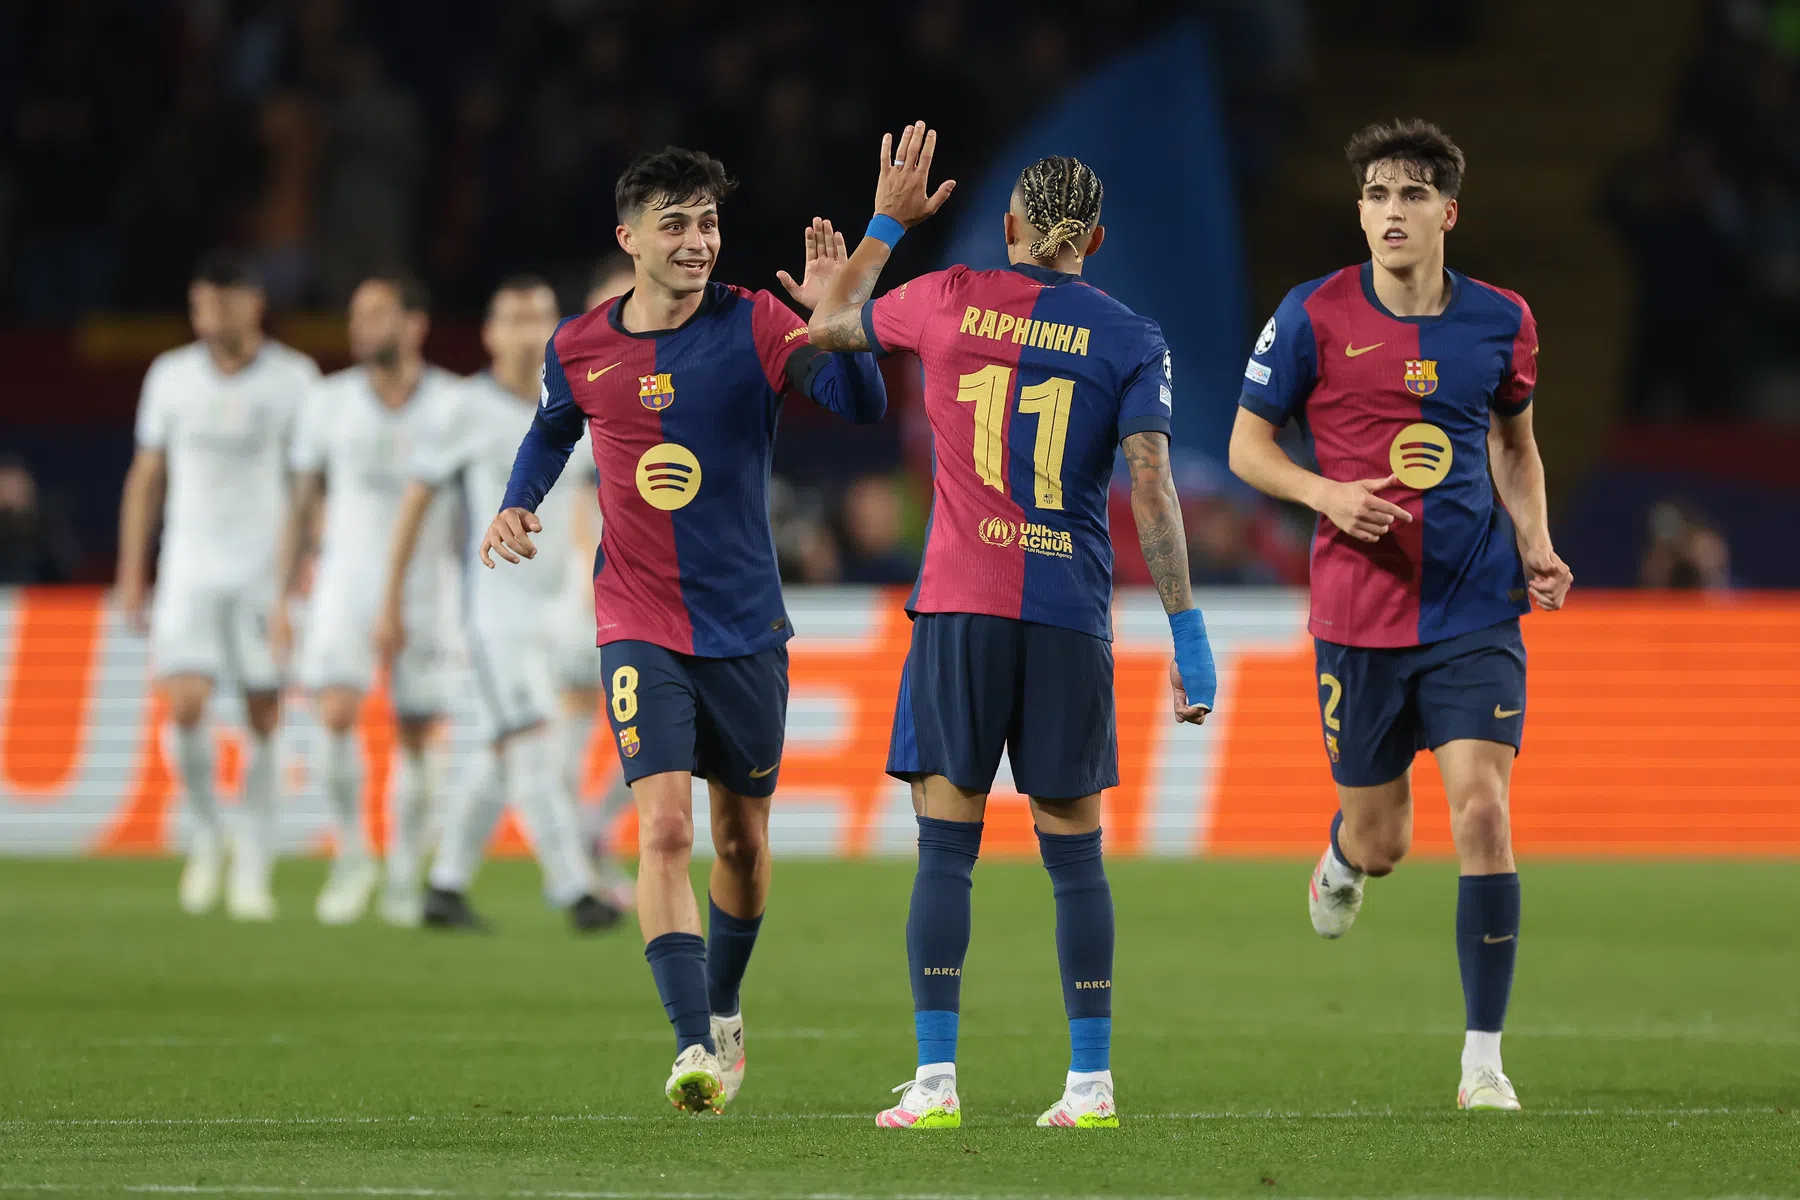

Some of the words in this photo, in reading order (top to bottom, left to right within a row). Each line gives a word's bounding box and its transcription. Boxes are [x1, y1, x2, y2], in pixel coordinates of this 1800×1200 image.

[784, 326, 809, 343] AMBIL
[959, 305, 1091, 356] RAPHINHA
[956, 364, 1076, 511] 11
[1020, 522, 1072, 543] UNHCR
[1018, 535, 1073, 554] ACNUR
[612, 665, 639, 723] 8
[1320, 673, 1342, 732] 2
[924, 967, 961, 977] BARÇA
[1075, 980, 1111, 990] BARÇA
